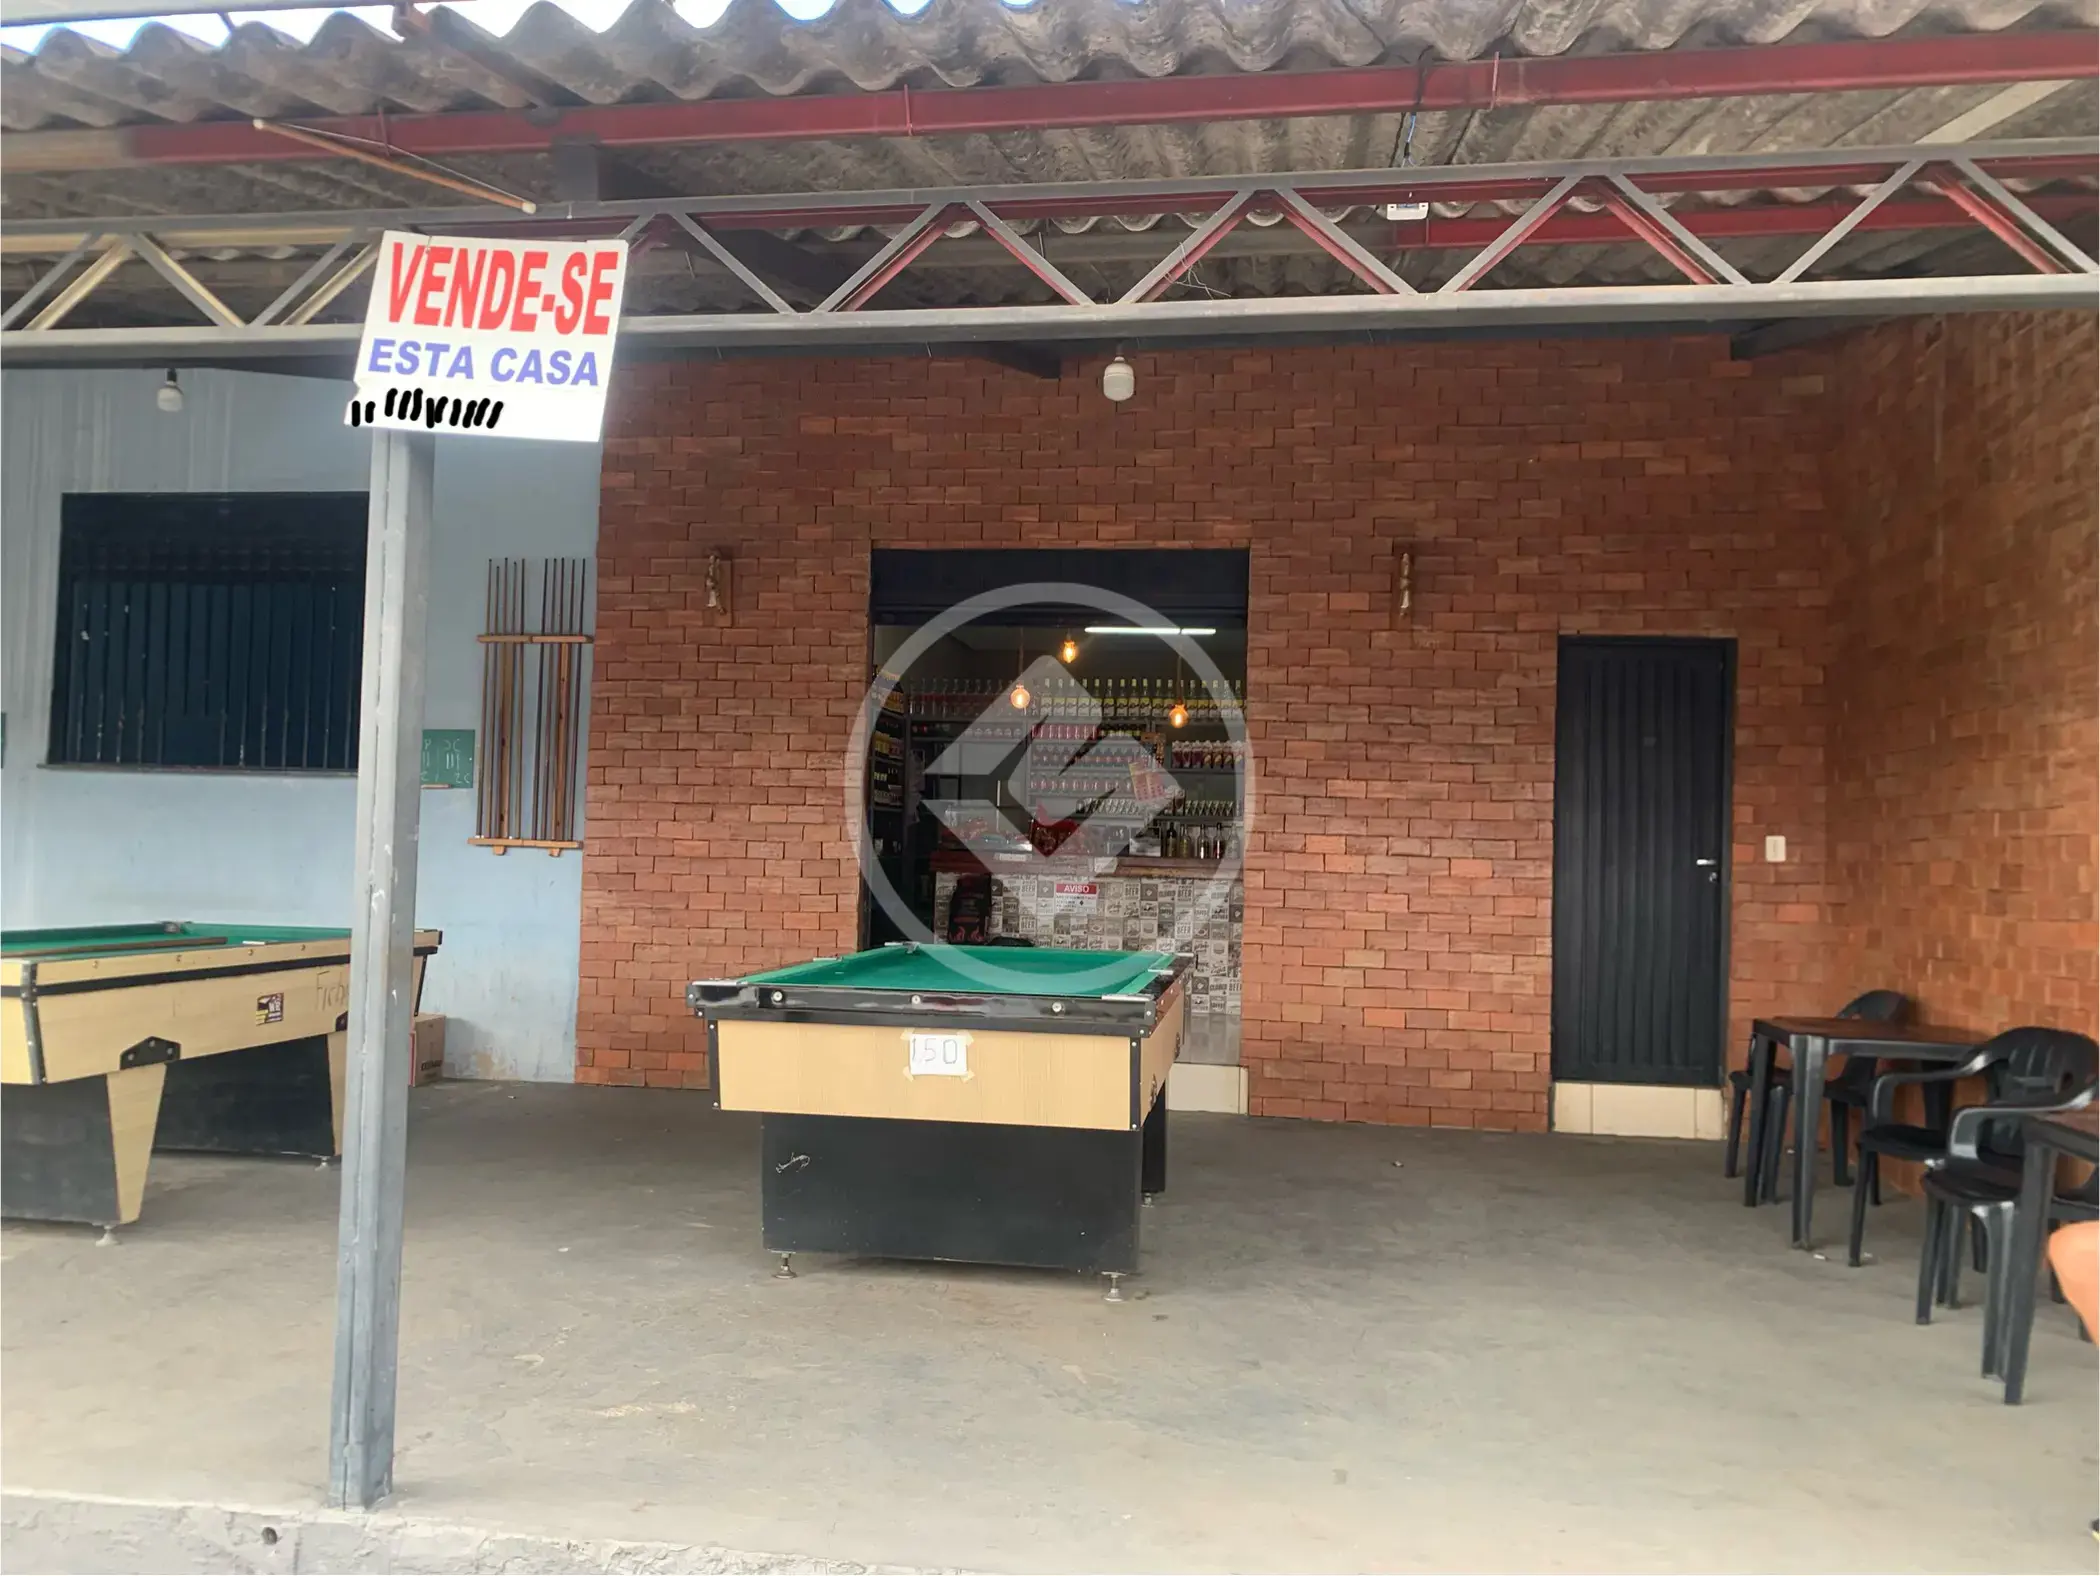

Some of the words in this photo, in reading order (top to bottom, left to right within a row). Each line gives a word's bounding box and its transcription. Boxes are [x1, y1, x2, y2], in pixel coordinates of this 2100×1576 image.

[388, 242, 619, 336] VENDE-SE
[367, 337, 474, 380] ESTA
[490, 347, 600, 387] CASA
[1063, 884, 1090, 894] AVISO
